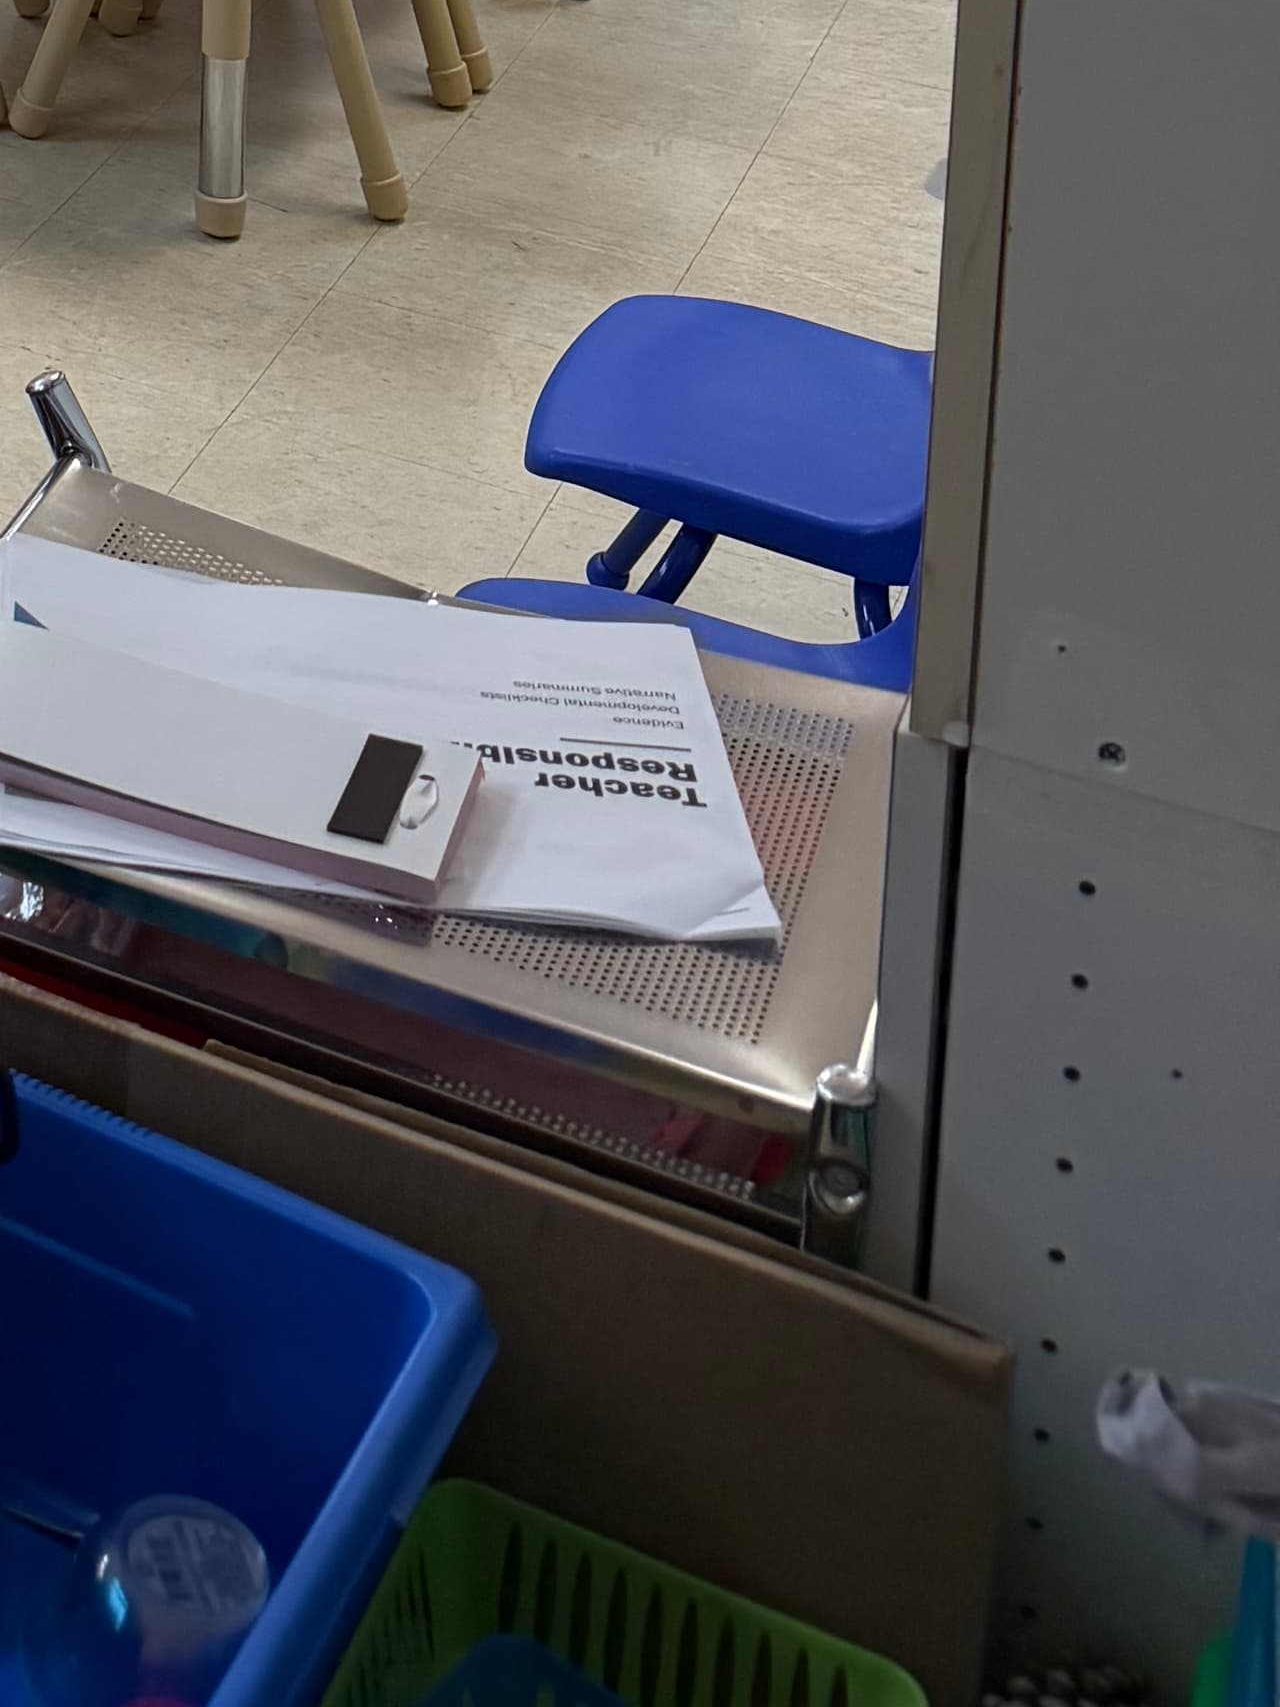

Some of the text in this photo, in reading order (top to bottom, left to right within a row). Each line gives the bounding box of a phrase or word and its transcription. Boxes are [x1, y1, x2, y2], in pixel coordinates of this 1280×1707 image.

[480, 690, 680, 715] Developmental Checklists
[513, 680, 676, 701] Narrative Summaries
[613, 716, 684, 730] Evidence
[450, 741, 698, 783] Responsib
[534, 771, 707, 808] Teacher
